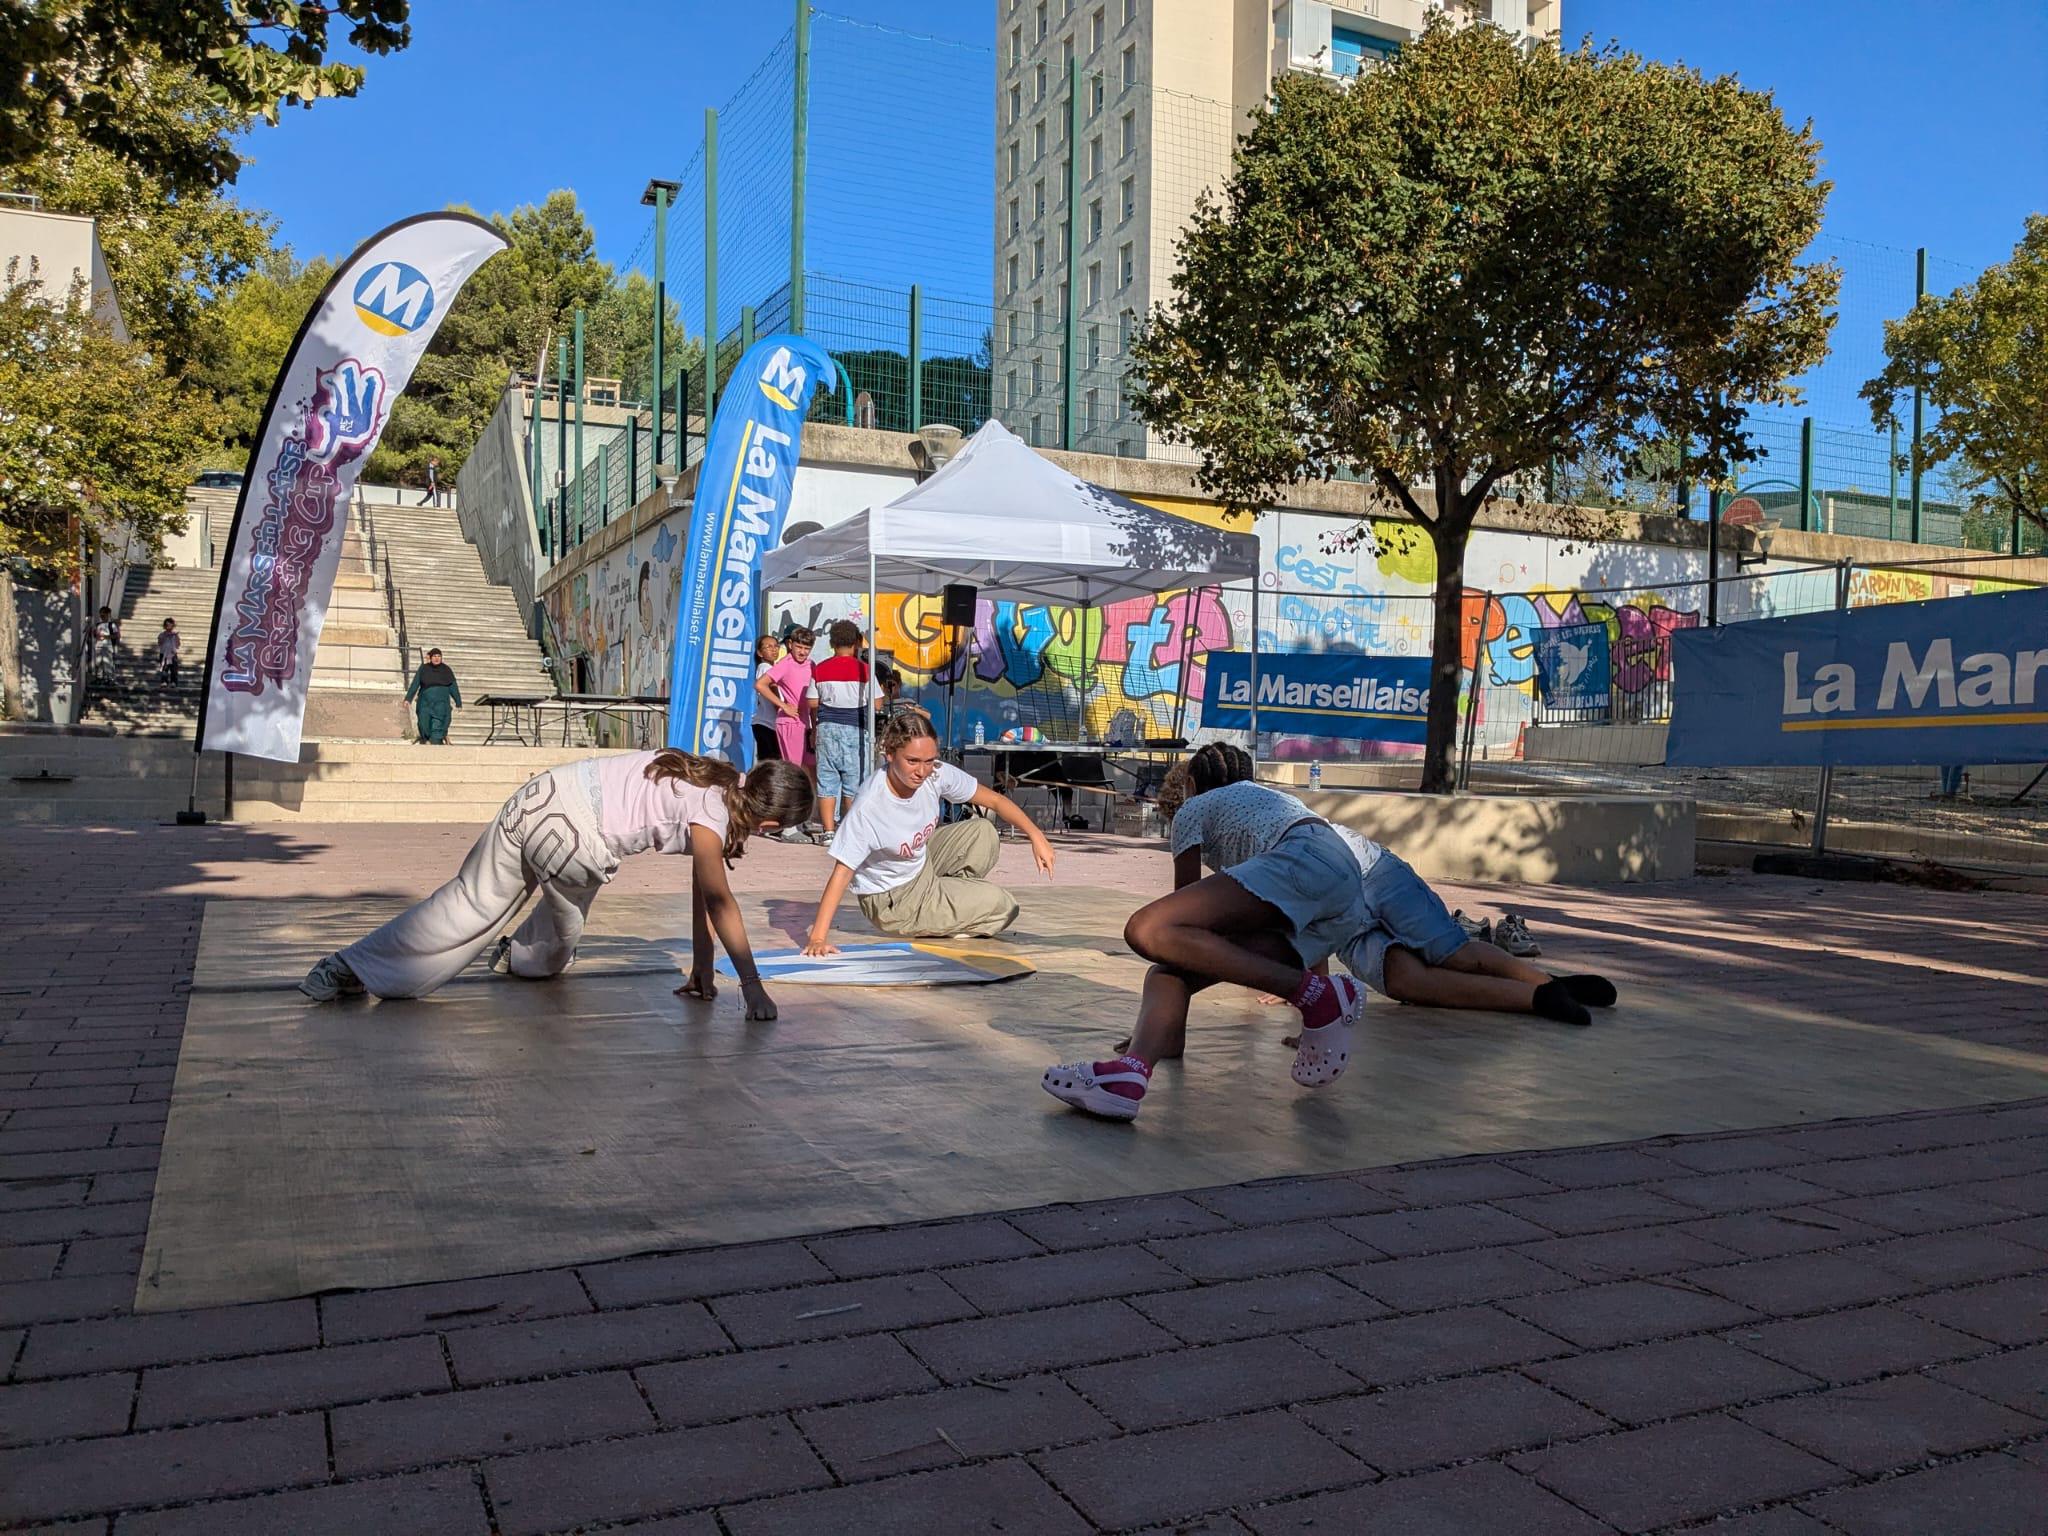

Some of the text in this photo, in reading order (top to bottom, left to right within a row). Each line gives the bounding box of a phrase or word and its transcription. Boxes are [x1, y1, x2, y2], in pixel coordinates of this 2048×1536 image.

[357, 263, 430, 327] M
[761, 346, 807, 403] M
[745, 423, 791, 479] La
[688, 512, 716, 646] www.lamarseillaise.fr
[223, 642, 257, 686] LA
[1217, 671, 1250, 703] La
[1782, 638, 2048, 716] La Mar
